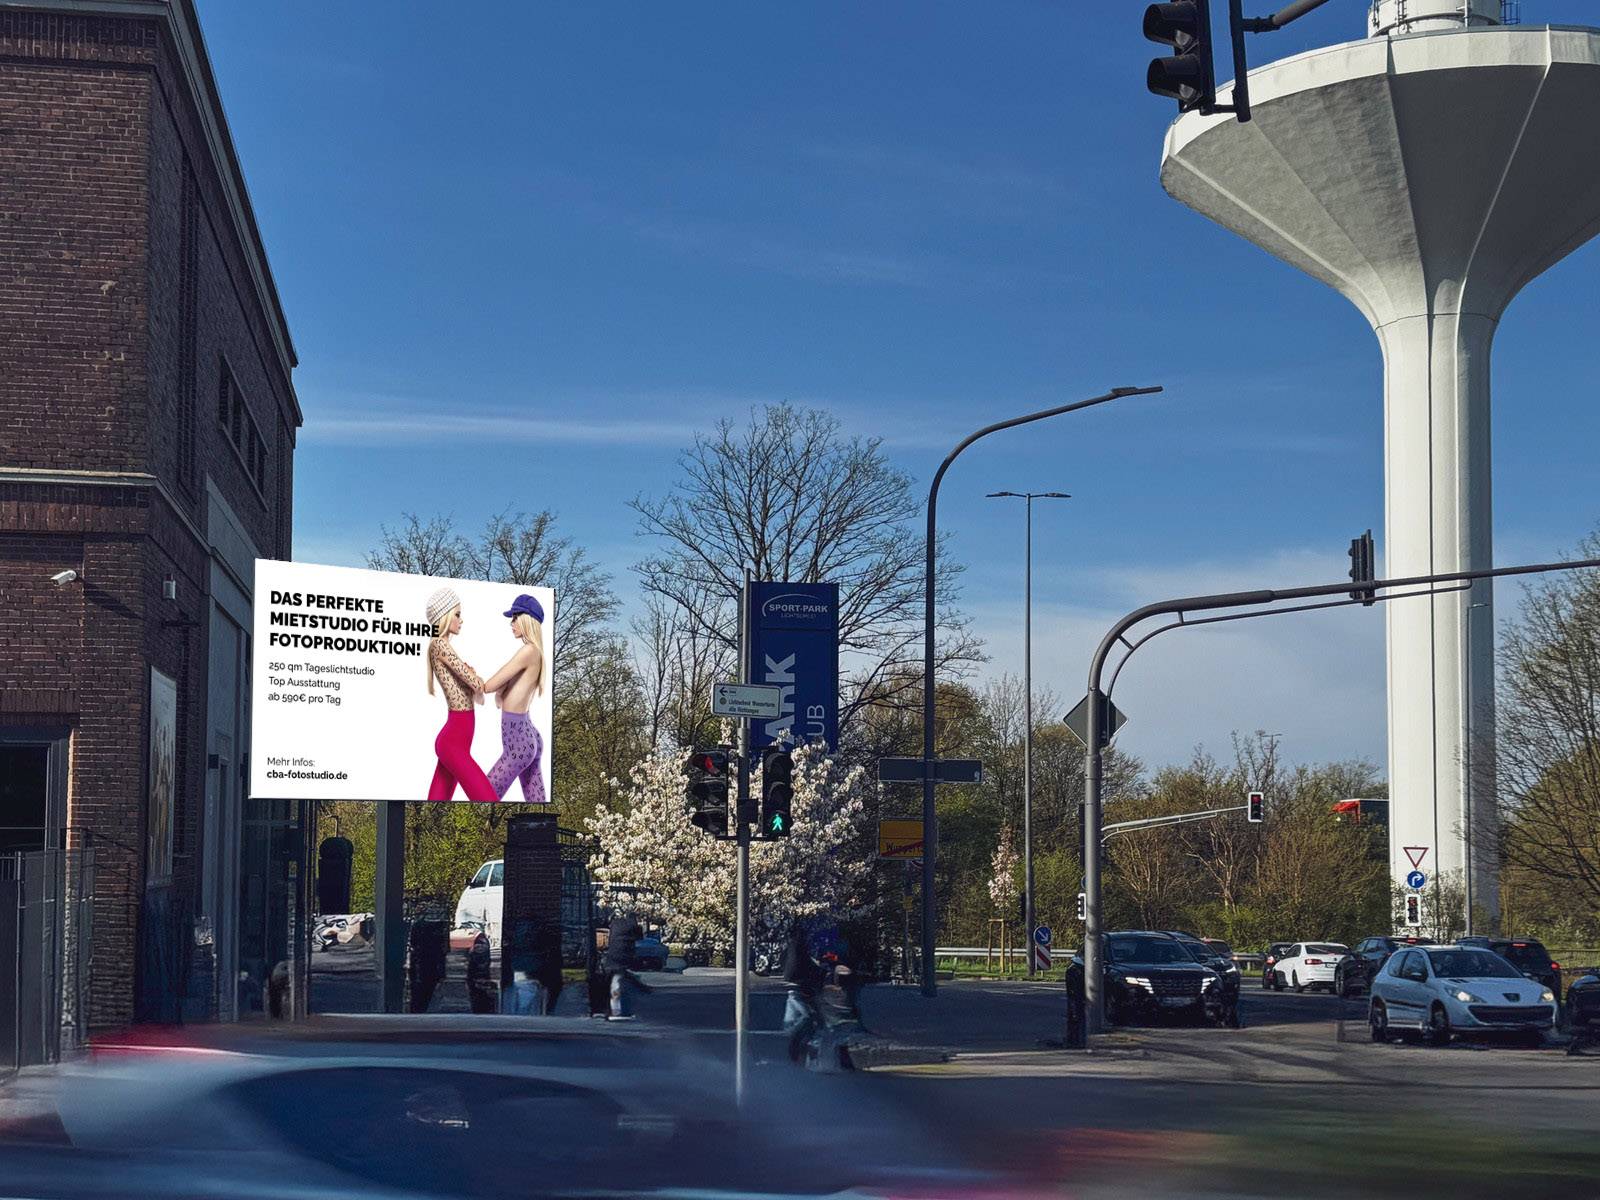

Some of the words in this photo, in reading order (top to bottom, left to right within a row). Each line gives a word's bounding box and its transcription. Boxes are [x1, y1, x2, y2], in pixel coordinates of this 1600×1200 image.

[270, 590, 302, 607] DAS
[306, 594, 384, 613] PERFEKTE
[769, 604, 828, 613] SPORT-PARK
[270, 611, 369, 632] MIETSTUDIO
[372, 617, 402, 635] FÜR
[405, 622, 440, 638] IHRE
[269, 632, 421, 656] FOTOPRODUKTION!
[268, 662, 286, 671] 250
[287, 663, 303, 673] qm
[304, 662, 375, 676] Tageslichtstudio
[268, 676, 286, 687] Top
[287, 677, 341, 691] Ausstattung
[267, 692, 280, 701] ab
[281, 693, 307, 703] 590€
[308, 695, 324, 704] pro
[325, 694, 341, 706] Tag
[267, 757, 290, 766] Mehr
[292, 757, 316, 767] Infos:
[266, 769, 348, 780] cba-fotostudio.de
